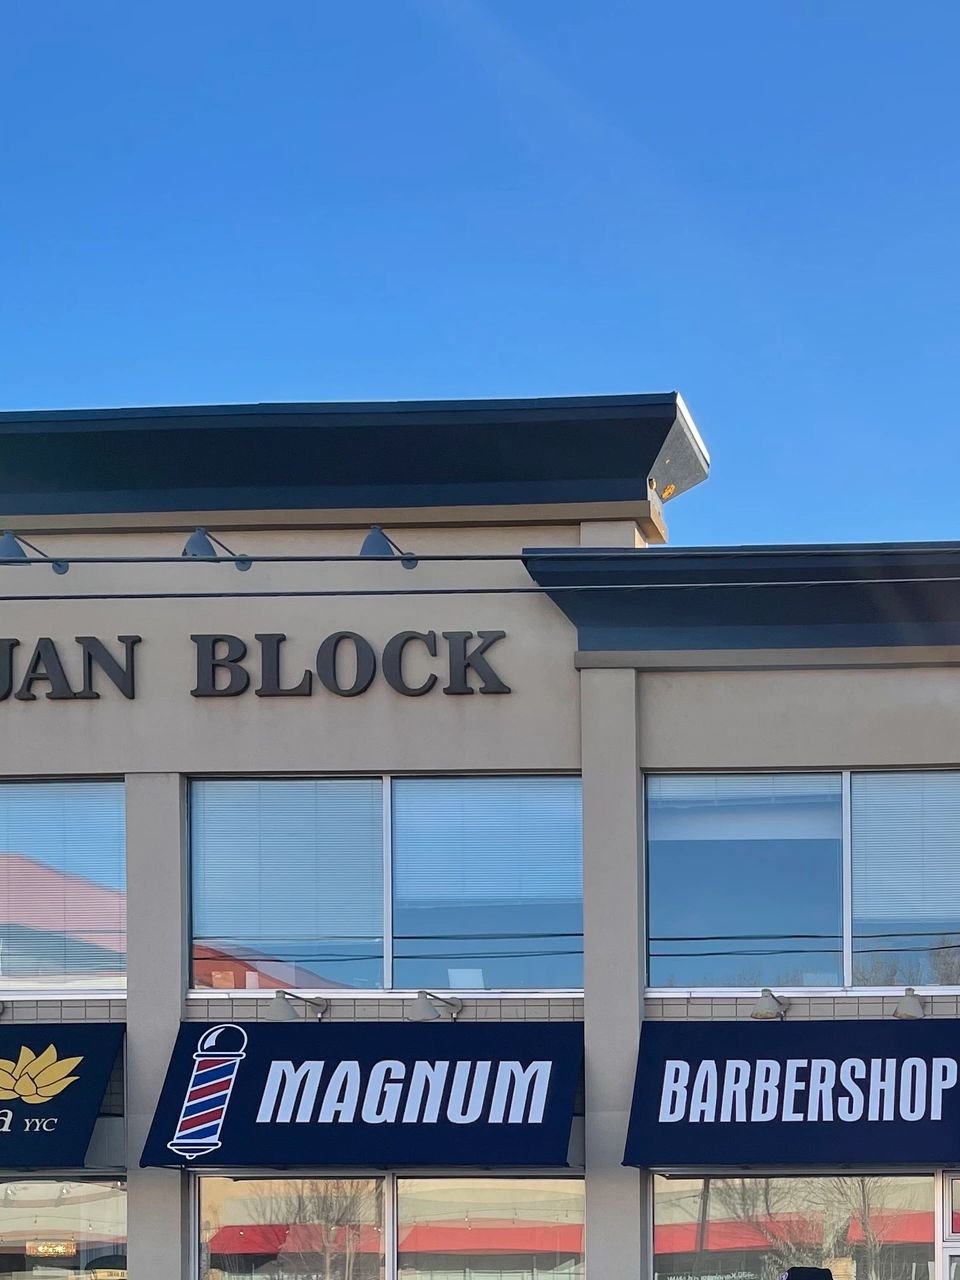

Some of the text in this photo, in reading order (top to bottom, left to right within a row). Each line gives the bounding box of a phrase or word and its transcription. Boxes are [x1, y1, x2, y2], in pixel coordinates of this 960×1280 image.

[190, 630, 511, 699] BLOCK
[255, 1059, 552, 1125] MAGNUM
[658, 1057, 958, 1123] BARBERSHOP
[24, 1117, 58, 1132] YYC
